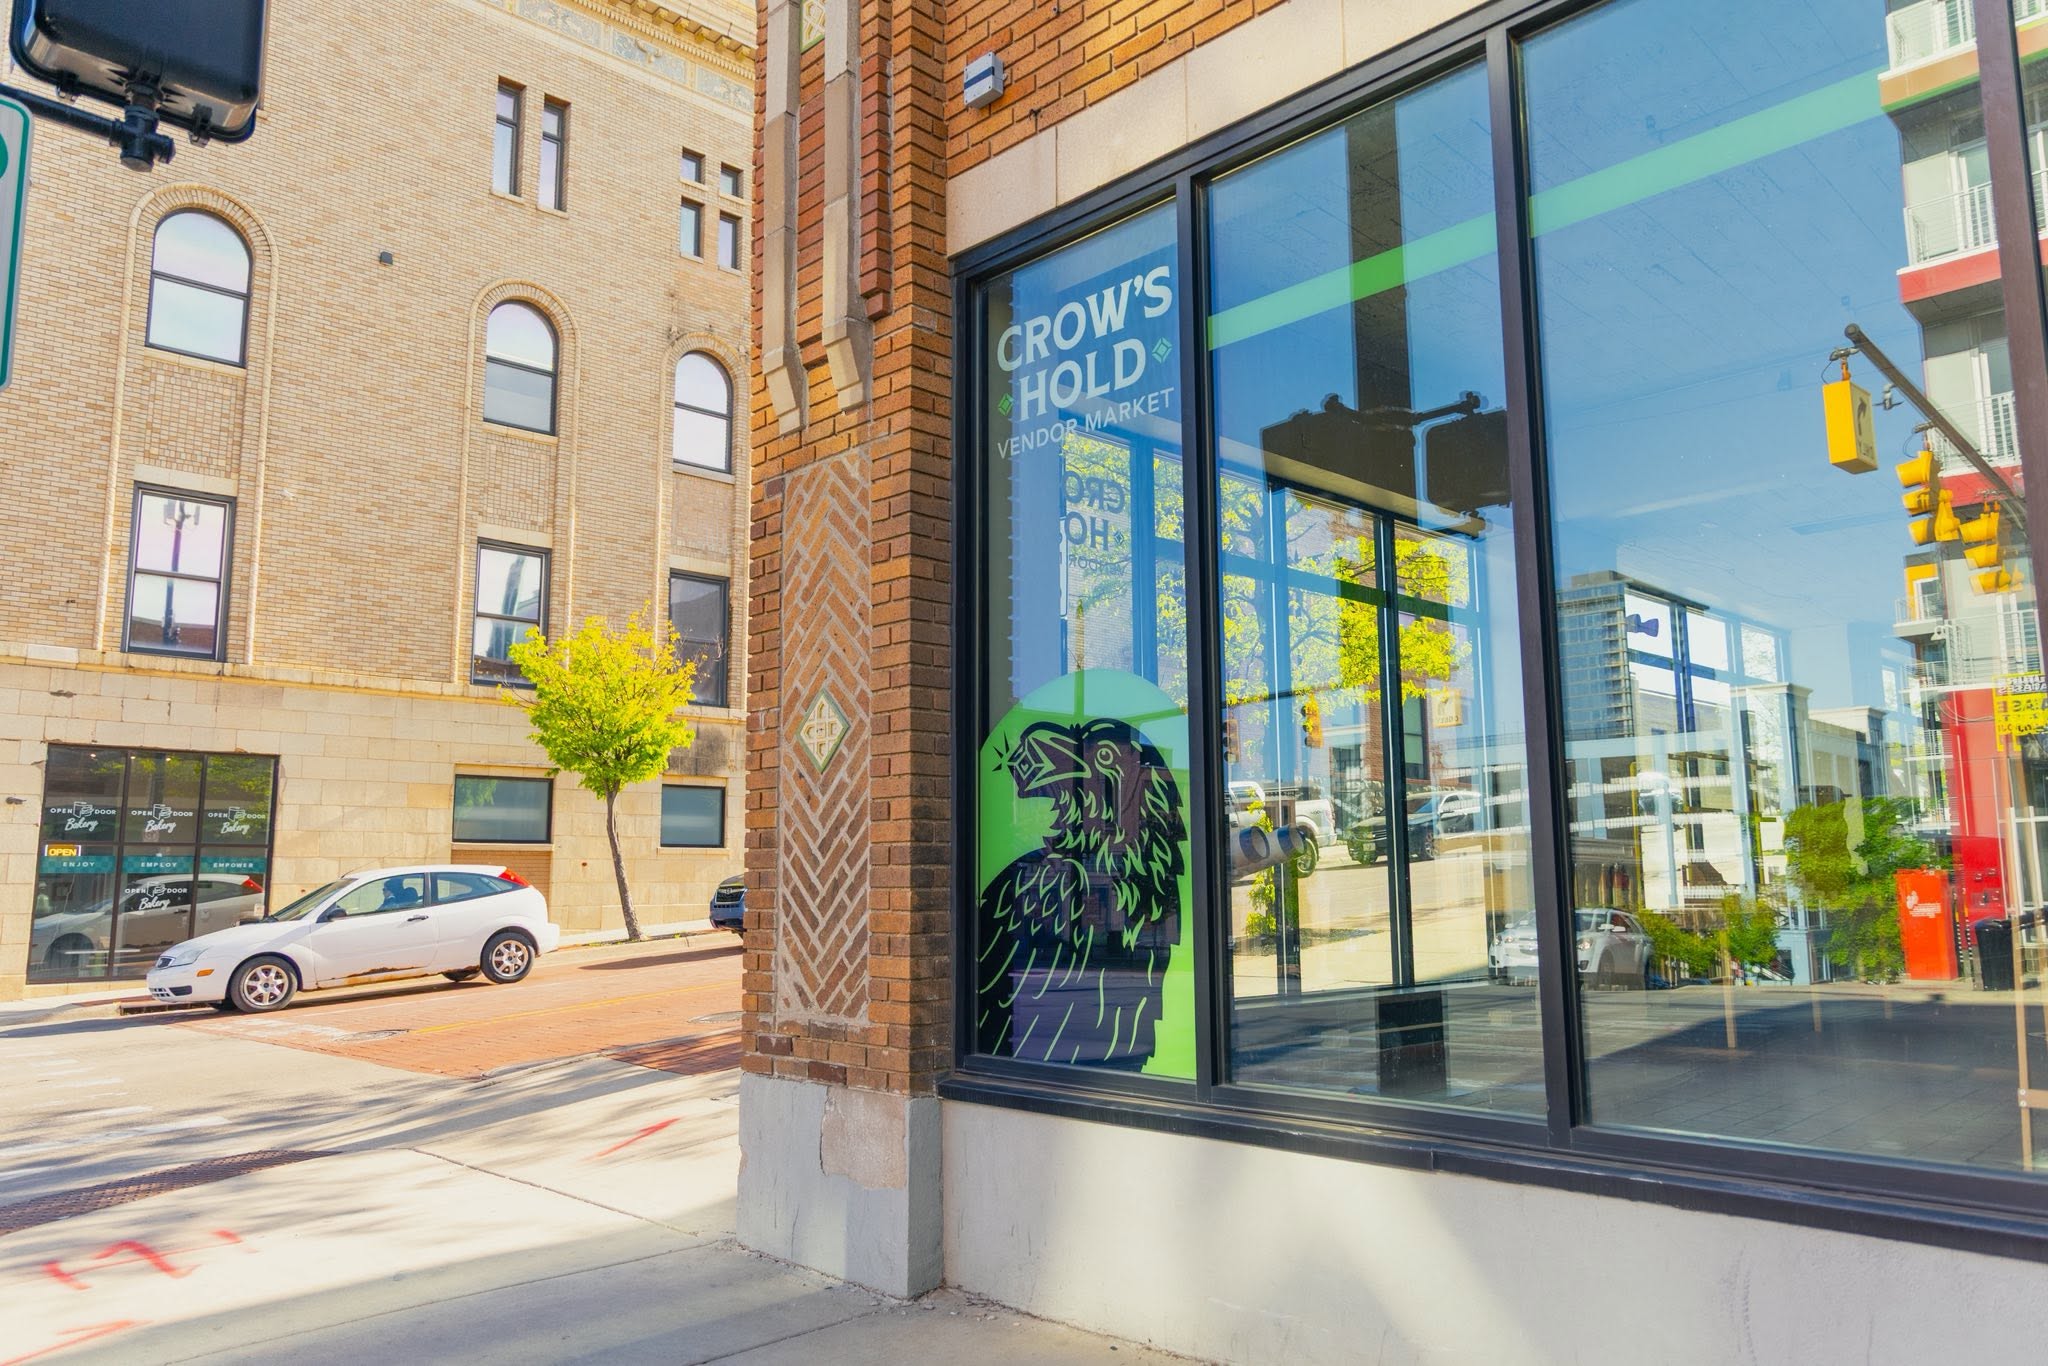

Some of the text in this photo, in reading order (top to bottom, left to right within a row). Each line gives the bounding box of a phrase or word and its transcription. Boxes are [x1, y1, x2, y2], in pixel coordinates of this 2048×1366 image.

[997, 265, 1173, 372] CROW'S
[1019, 338, 1146, 422] HOLD
[997, 387, 1175, 460] VENDOR MARKET
[64, 816, 99, 832] Bakery
[145, 819, 177, 833] Bakery
[220, 821, 251, 835] Bakery
[48, 848, 77, 857] OPEN
[138, 896, 171, 911] Bakery
